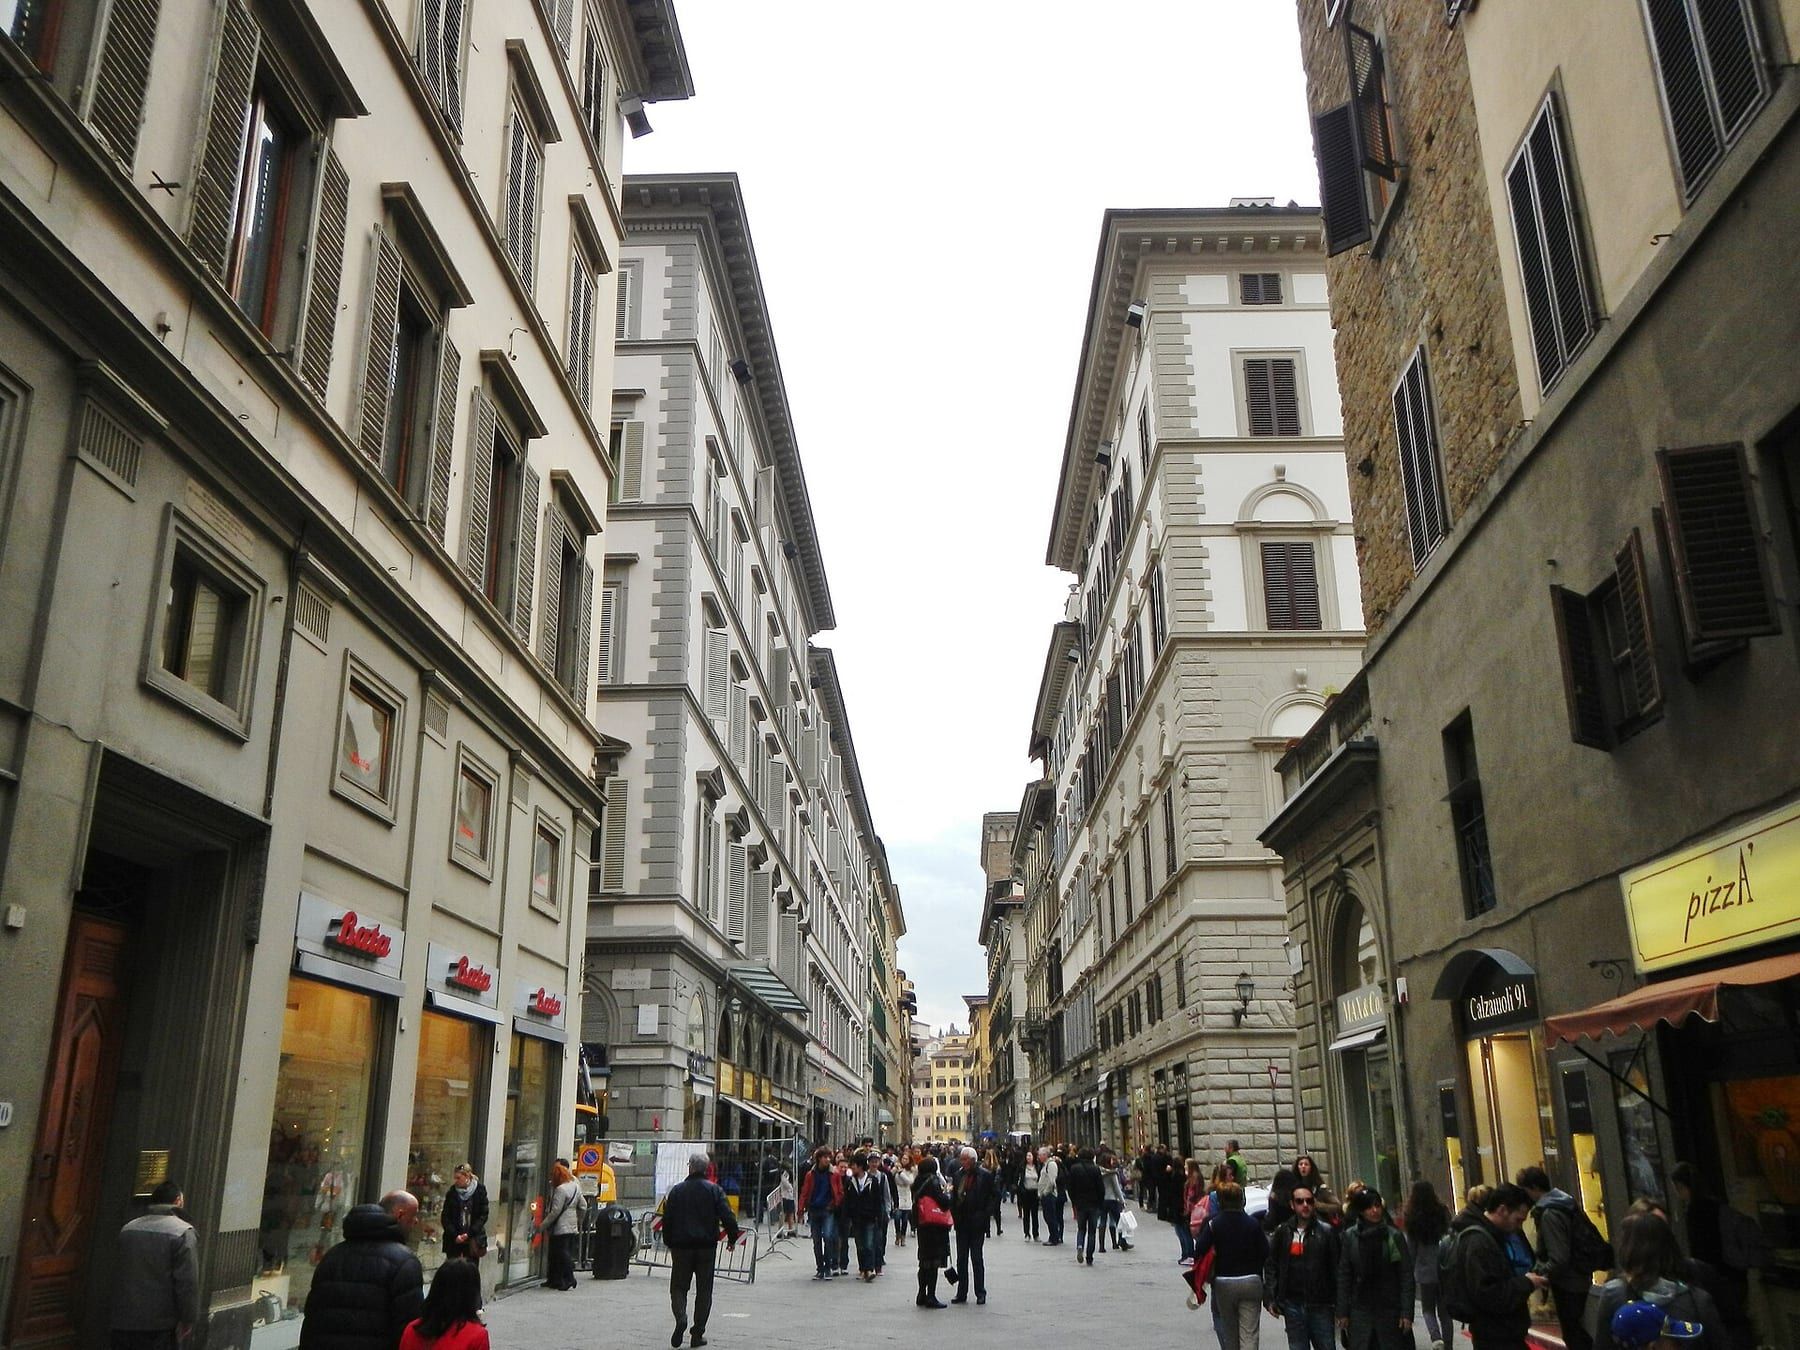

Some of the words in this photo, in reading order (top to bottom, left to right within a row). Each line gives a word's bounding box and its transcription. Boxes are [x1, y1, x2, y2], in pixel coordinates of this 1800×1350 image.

[336, 911, 391, 957] Bata
[455, 956, 491, 992] Bata
[1470, 986, 1514, 1021] Calzaiuoli
[1514, 984, 1527, 1009] 91
